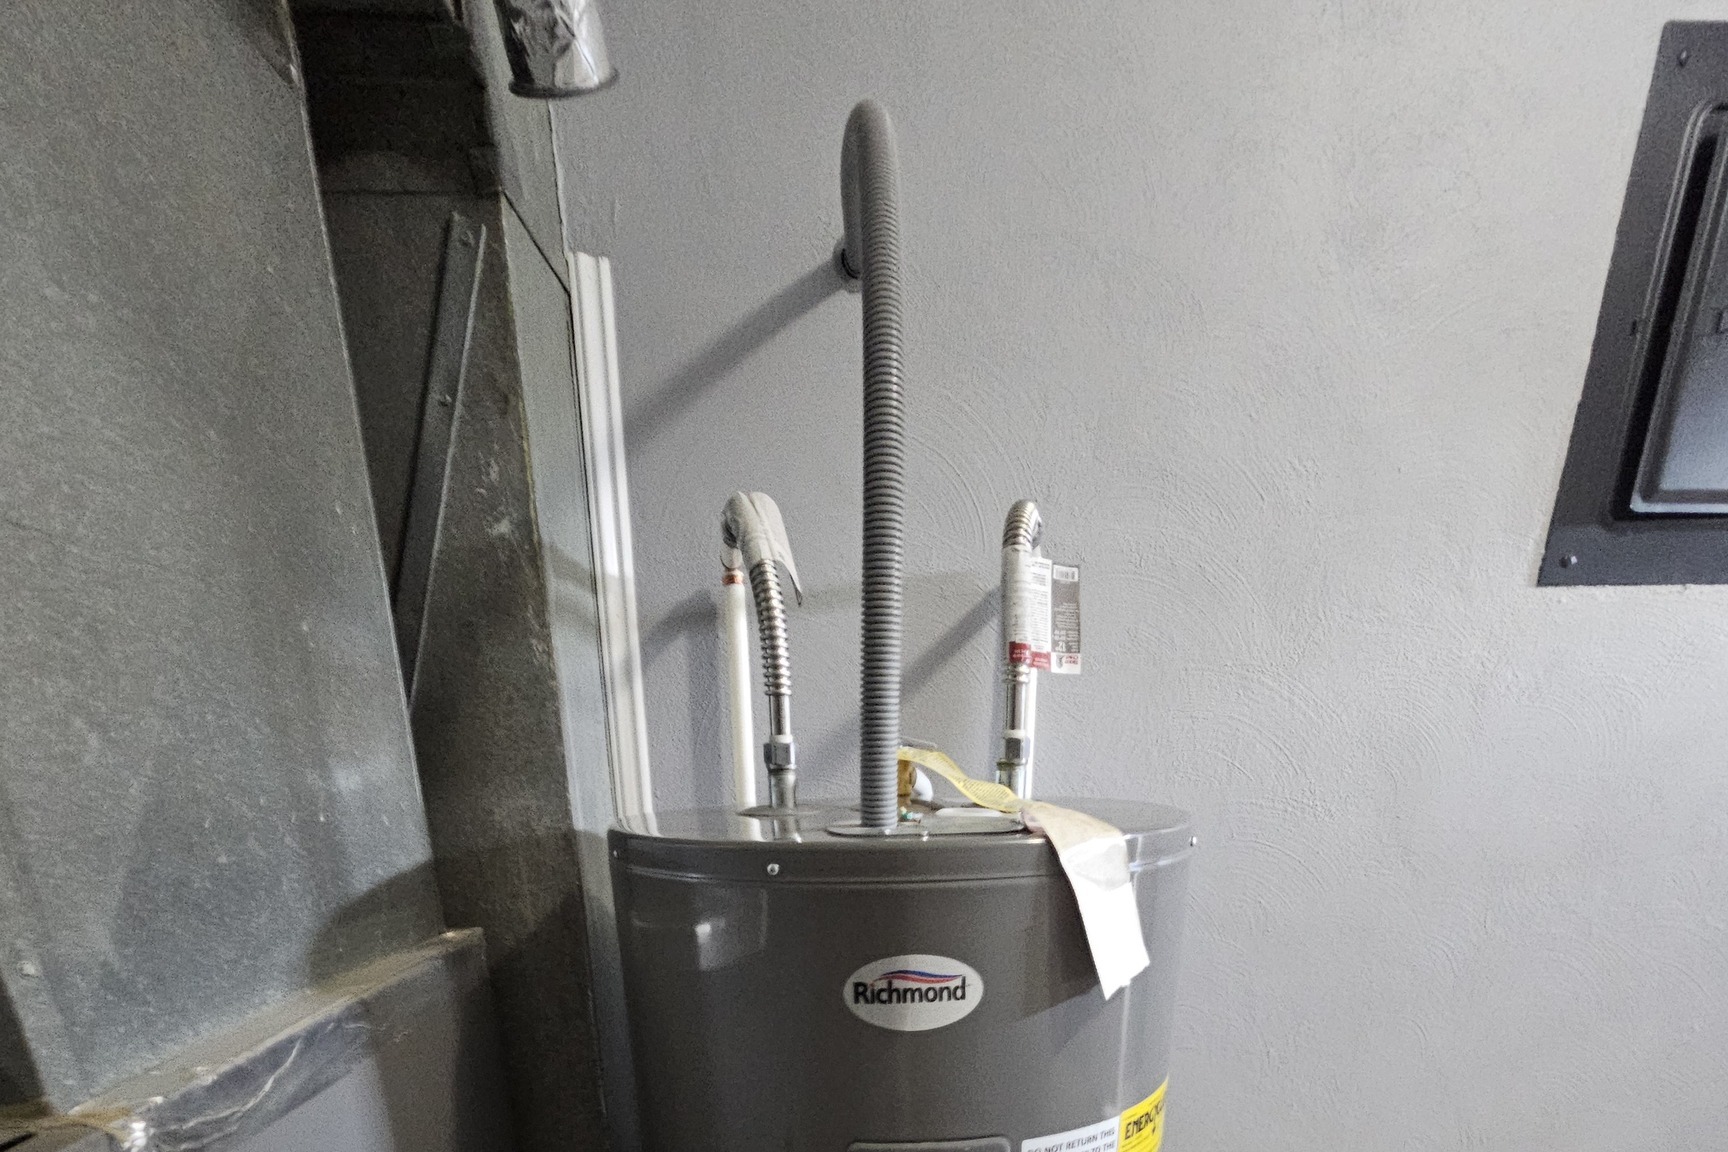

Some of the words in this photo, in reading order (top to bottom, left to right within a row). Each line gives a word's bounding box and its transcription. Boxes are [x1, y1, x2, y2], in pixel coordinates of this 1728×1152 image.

[853, 976, 966, 1004] Richmond
[1065, 1134, 1098, 1150] RETURN
[1100, 1126, 1116, 1140] THIS
[1103, 1140, 1116, 1152] THE
